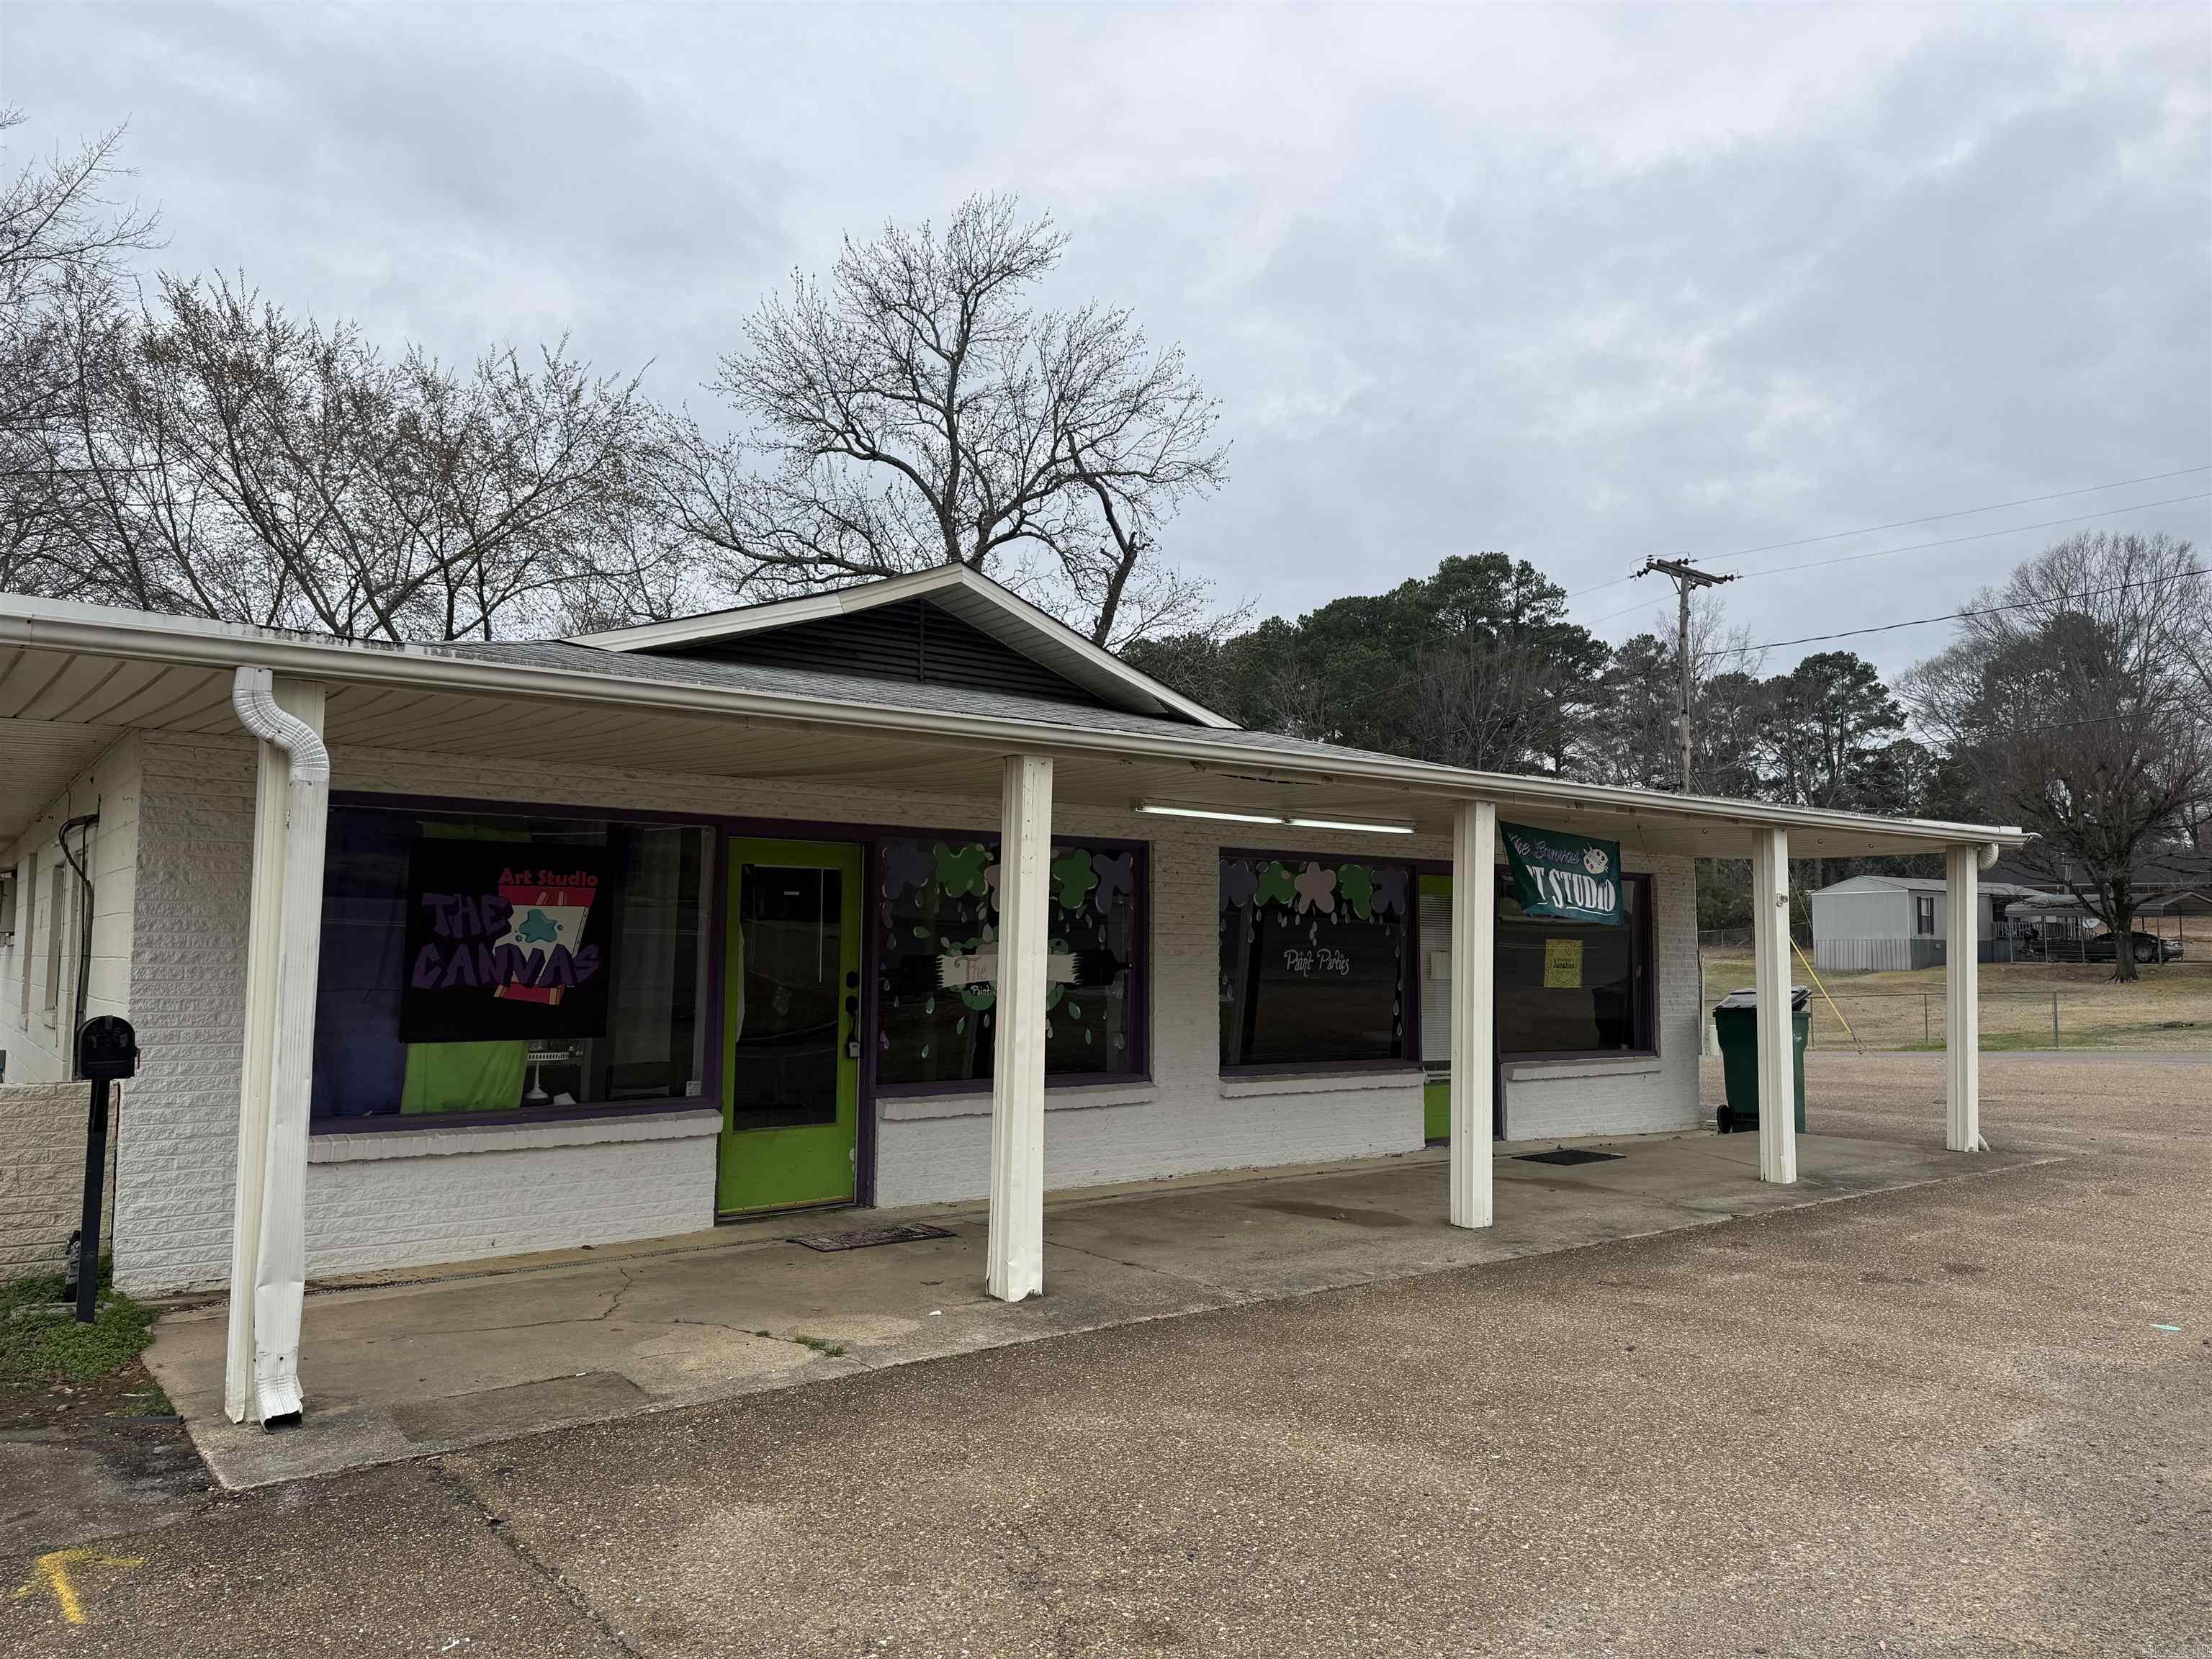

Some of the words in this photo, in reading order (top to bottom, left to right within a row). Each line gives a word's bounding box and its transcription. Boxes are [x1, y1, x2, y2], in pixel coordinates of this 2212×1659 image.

[498, 867, 533, 886] Art
[537, 869, 599, 887] Studio
[421, 891, 512, 939] THE
[410, 942, 601, 990] CANVAS
[1316, 948, 1350, 976] Parties
